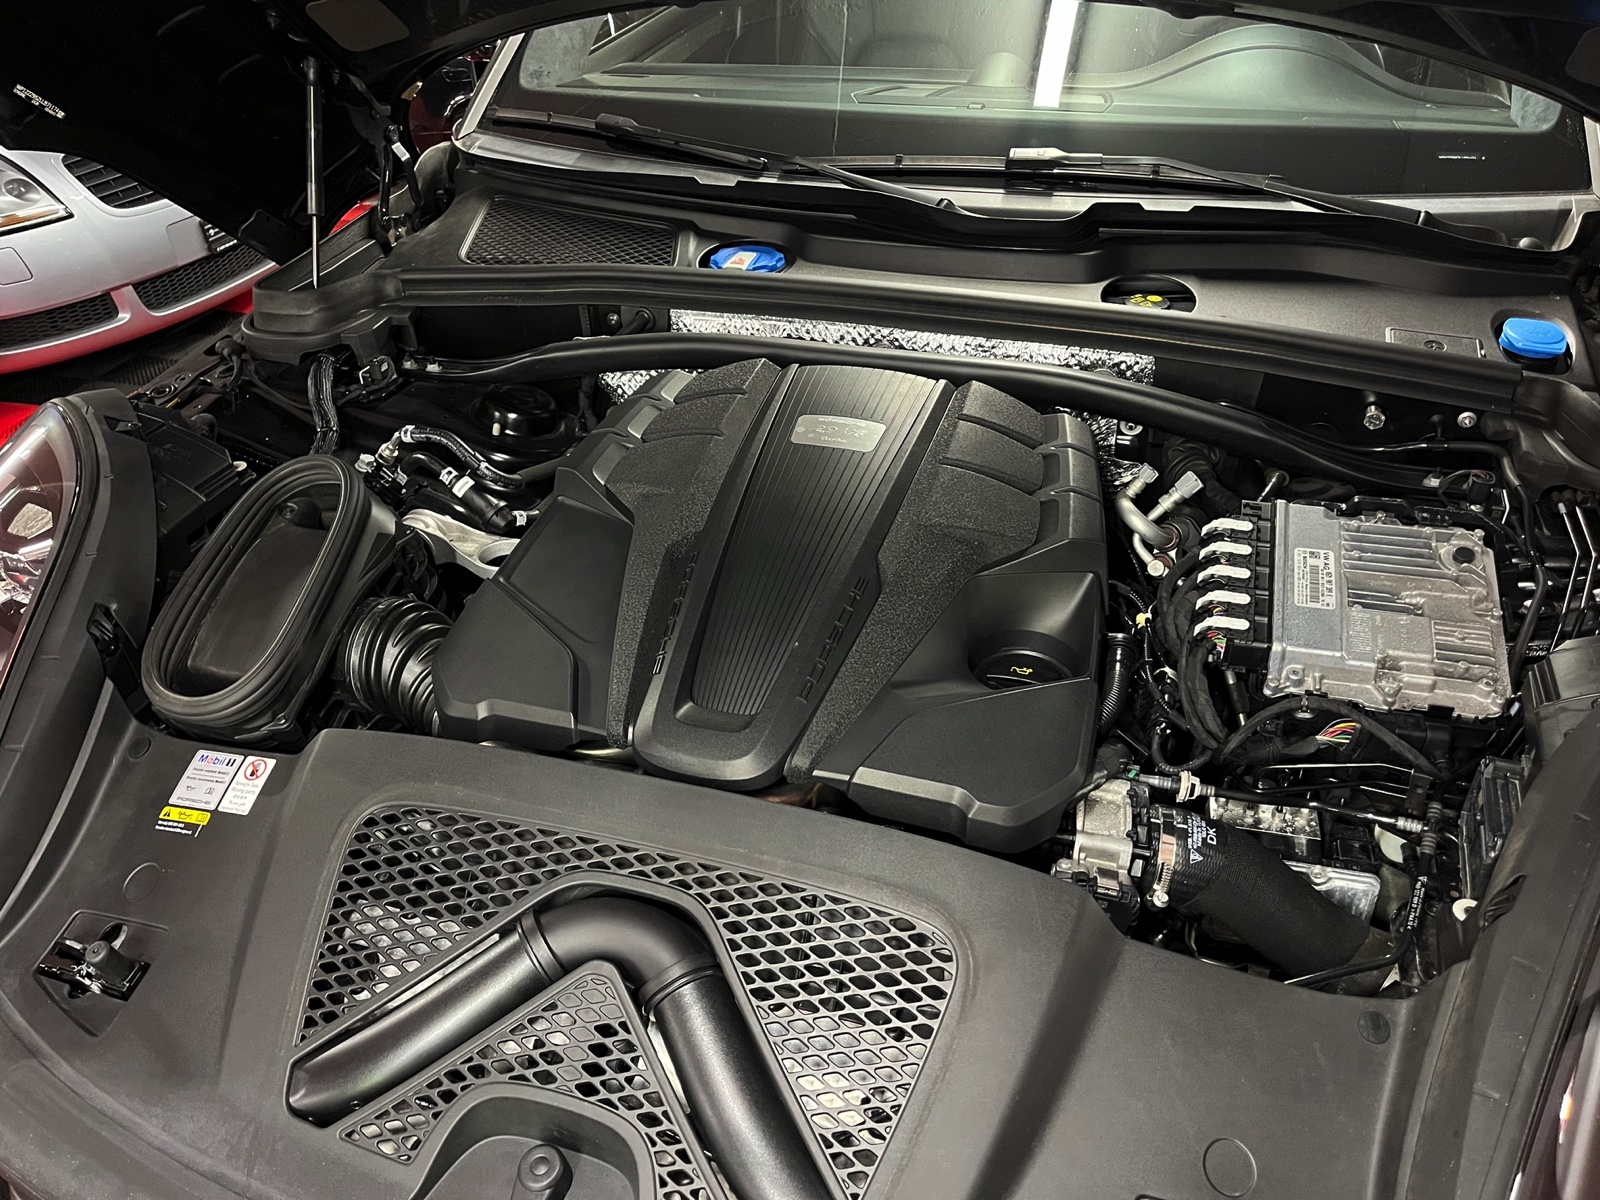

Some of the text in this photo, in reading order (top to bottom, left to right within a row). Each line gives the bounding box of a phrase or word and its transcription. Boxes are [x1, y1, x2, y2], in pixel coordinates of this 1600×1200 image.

[796, 576, 870, 704] PORSCHE
[198, 754, 227, 766] Mobil
[1207, 826, 1217, 845] DK
